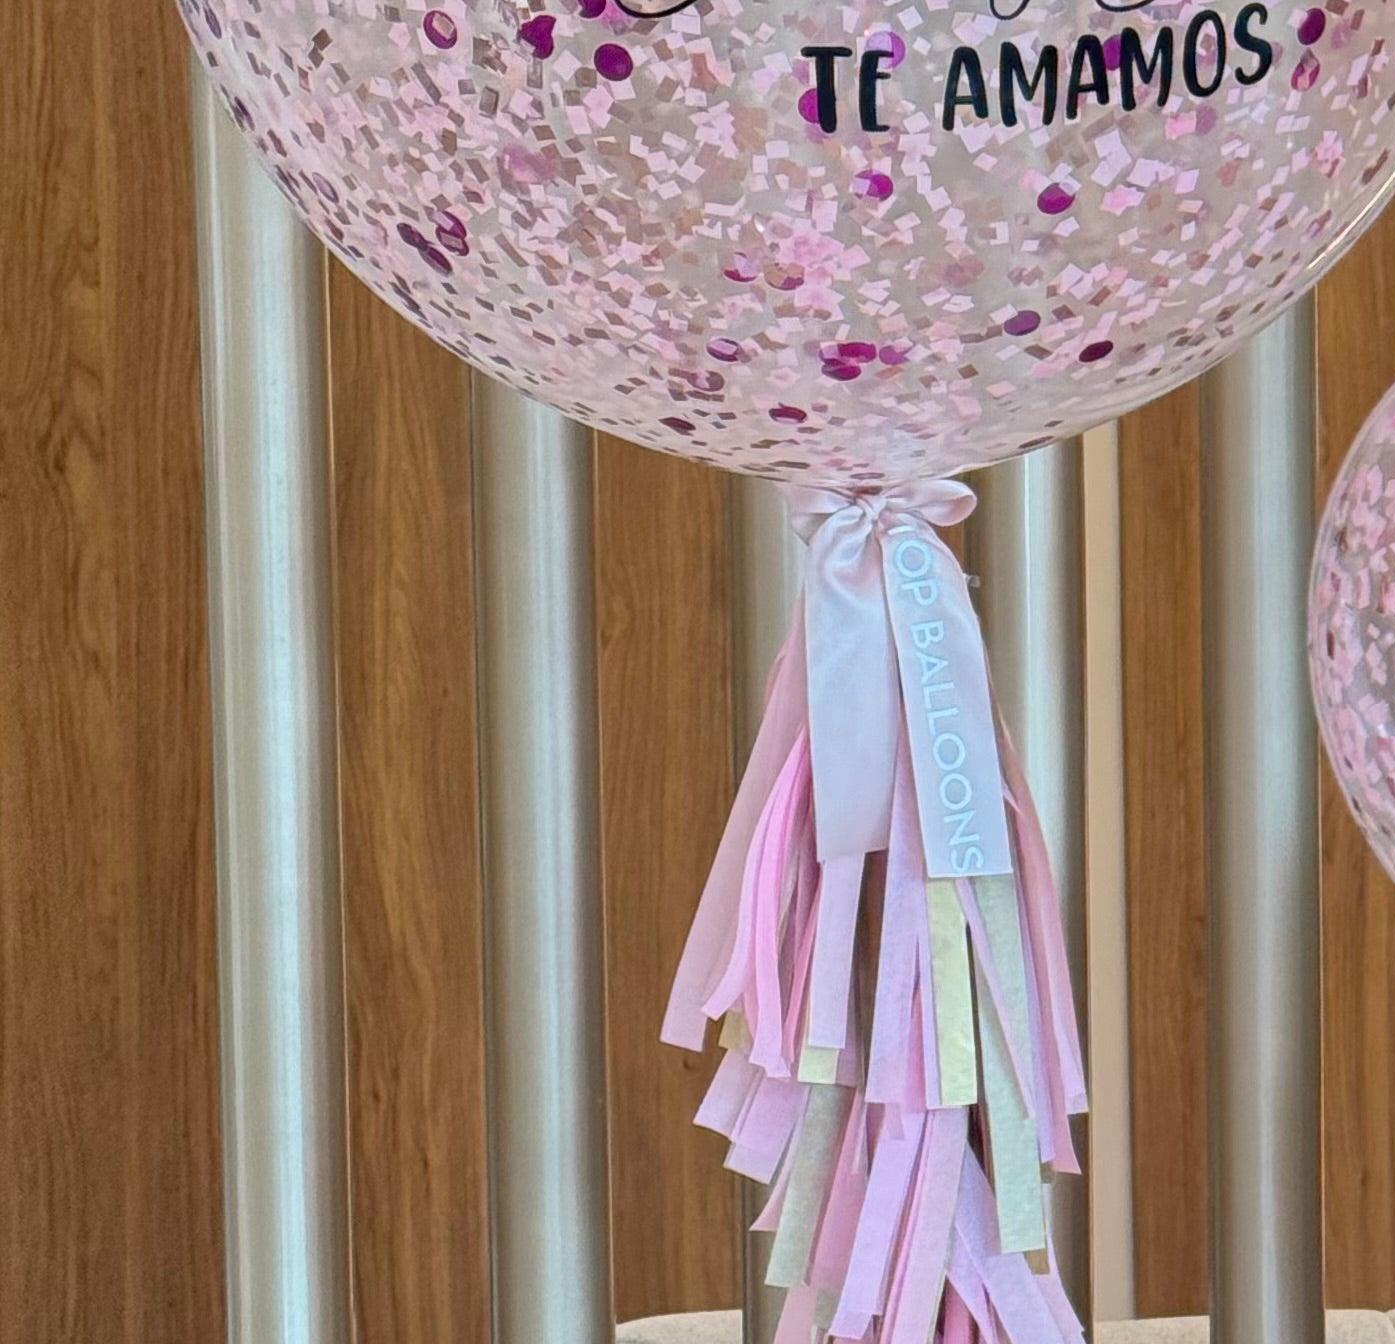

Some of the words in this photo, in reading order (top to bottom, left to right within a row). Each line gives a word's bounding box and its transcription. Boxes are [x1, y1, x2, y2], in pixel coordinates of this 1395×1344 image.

[801, 46, 893, 134] TE
[942, 2, 1274, 131] AMAMOS
[910, 619, 985, 874] BALLOONS
